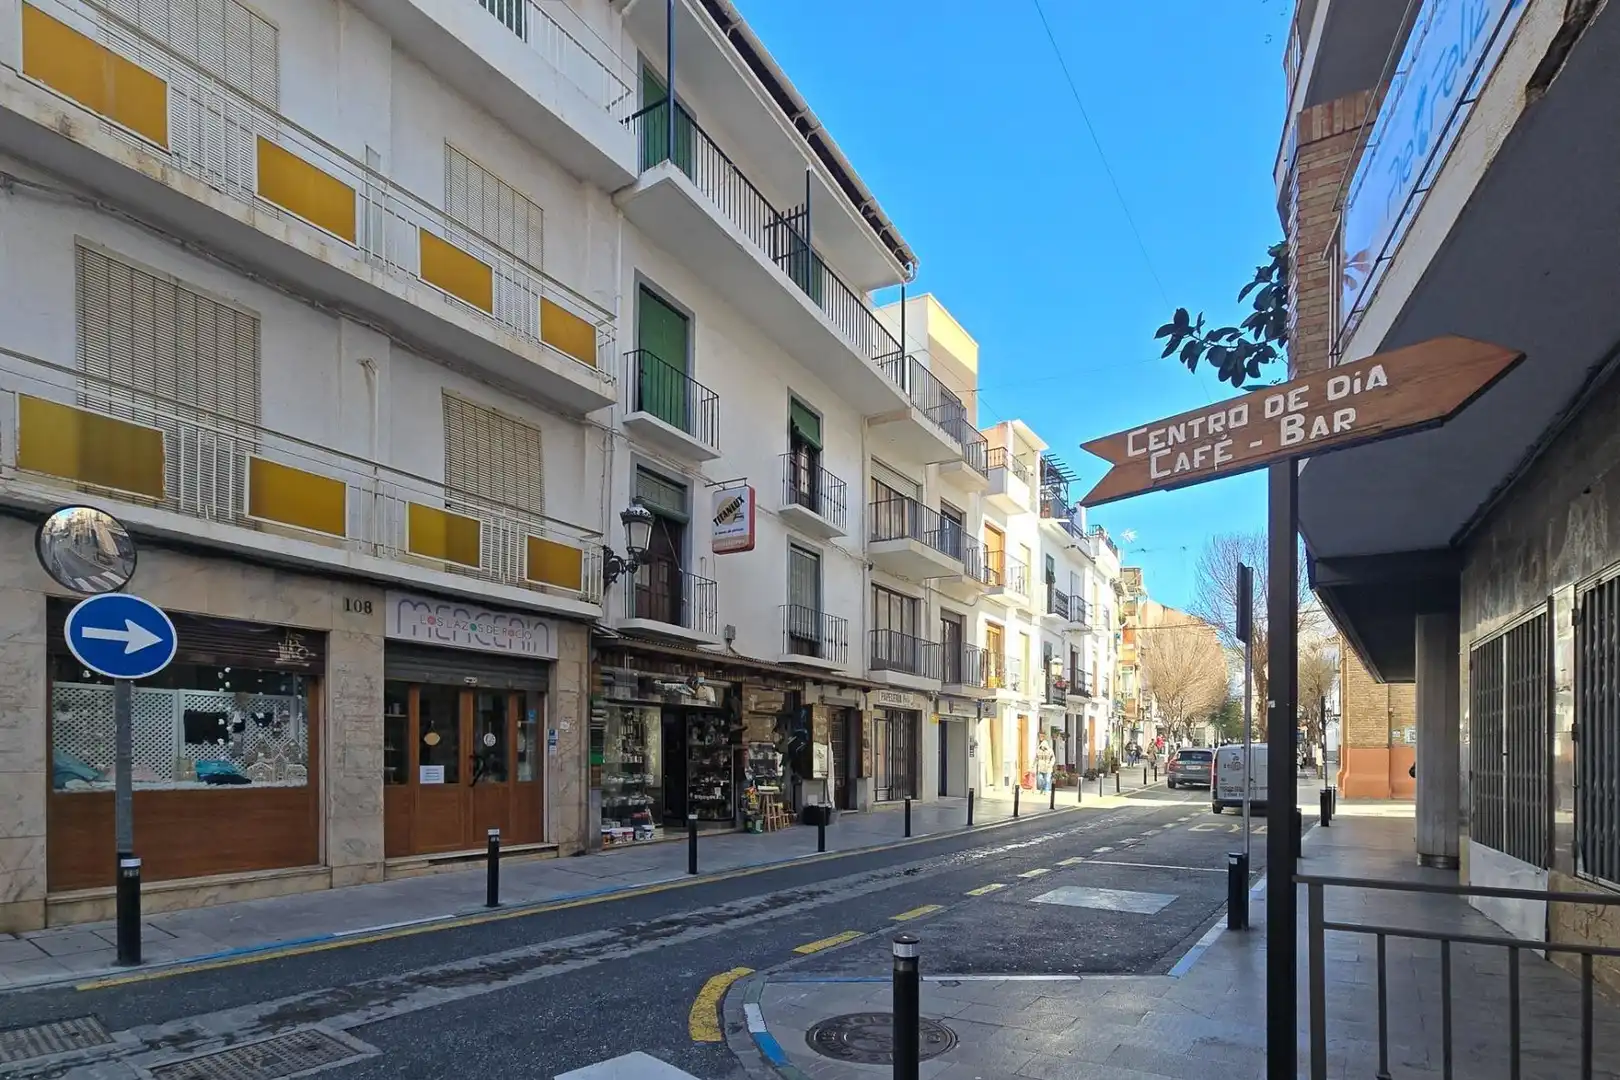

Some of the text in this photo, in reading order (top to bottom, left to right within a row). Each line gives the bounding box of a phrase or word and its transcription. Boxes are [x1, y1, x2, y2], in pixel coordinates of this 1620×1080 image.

[1127, 403, 1249, 457] CENTRO
[1264, 385, 1310, 419] DE
[1150, 434, 1234, 480] CAFÉ
[1280, 407, 1357, 447] BAR
[712, 495, 745, 526] TITANLUX
[343, 597, 373, 615] 108
[420, 615, 444, 627] LOS
[446, 619, 484, 634] LAZOS
[486, 624, 500, 636] DE
